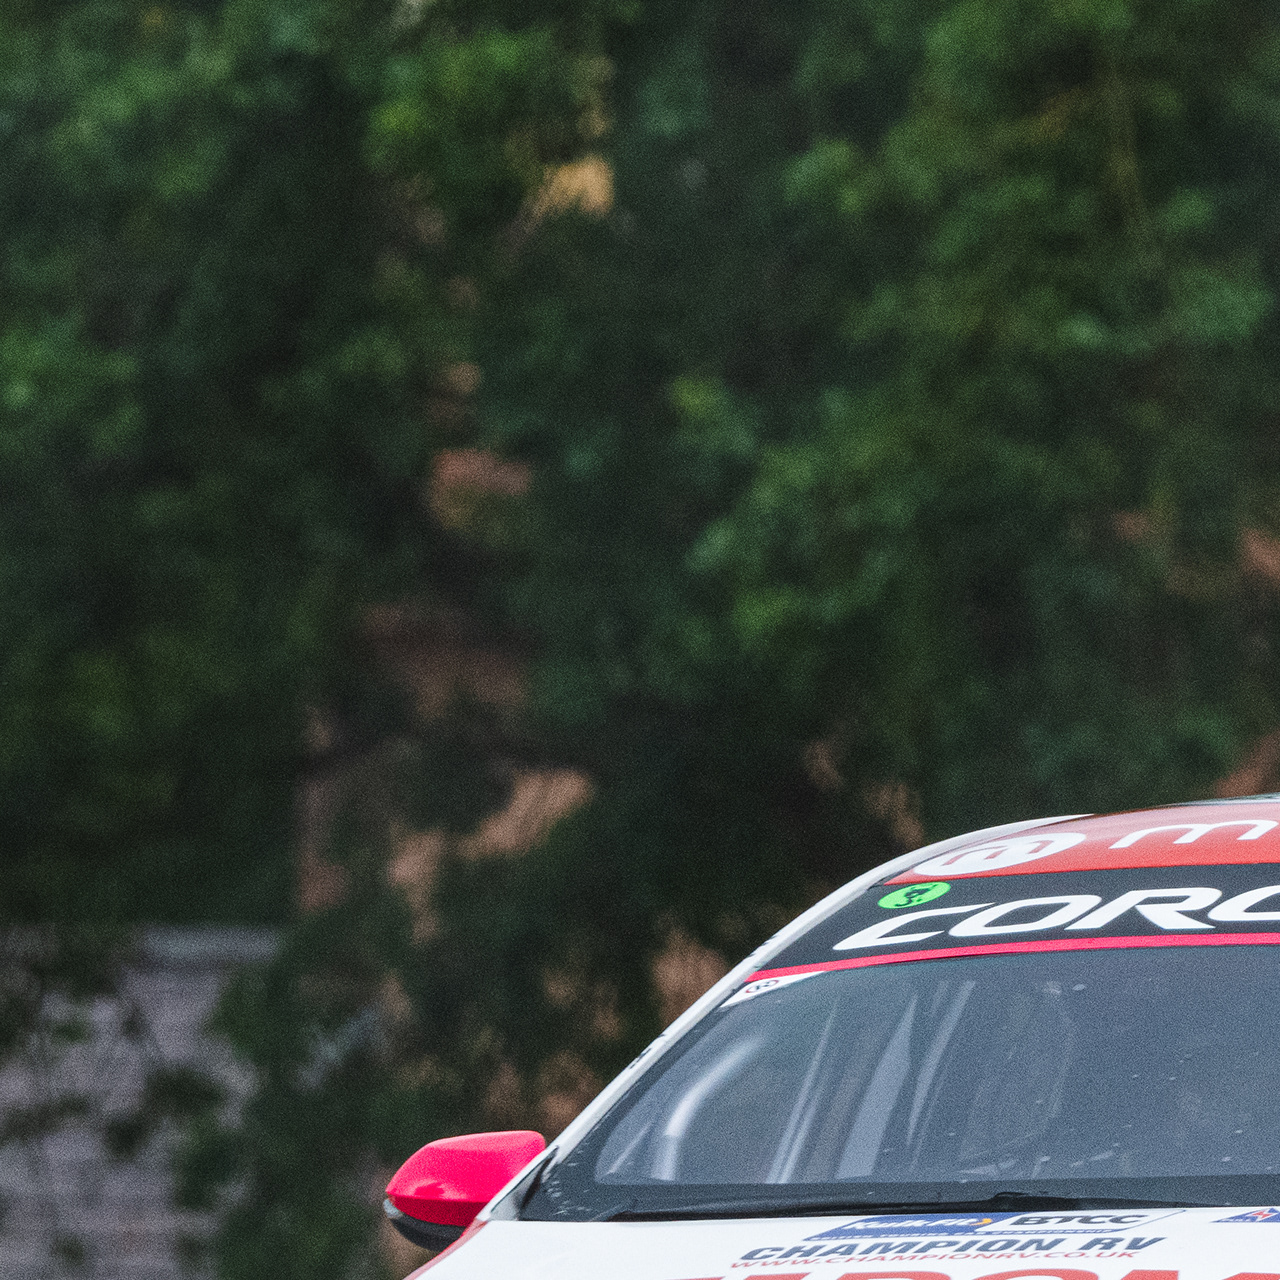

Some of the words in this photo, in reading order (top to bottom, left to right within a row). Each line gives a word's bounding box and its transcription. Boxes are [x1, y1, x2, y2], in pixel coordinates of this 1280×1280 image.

[1011, 1214, 1151, 1227] BTCC
[739, 1237, 1057, 1263] CHAMPION
[1069, 1236, 1168, 1252] RV
[731, 1251, 1141, 1269] WWW.CHAMPIONRV.CO.UK
